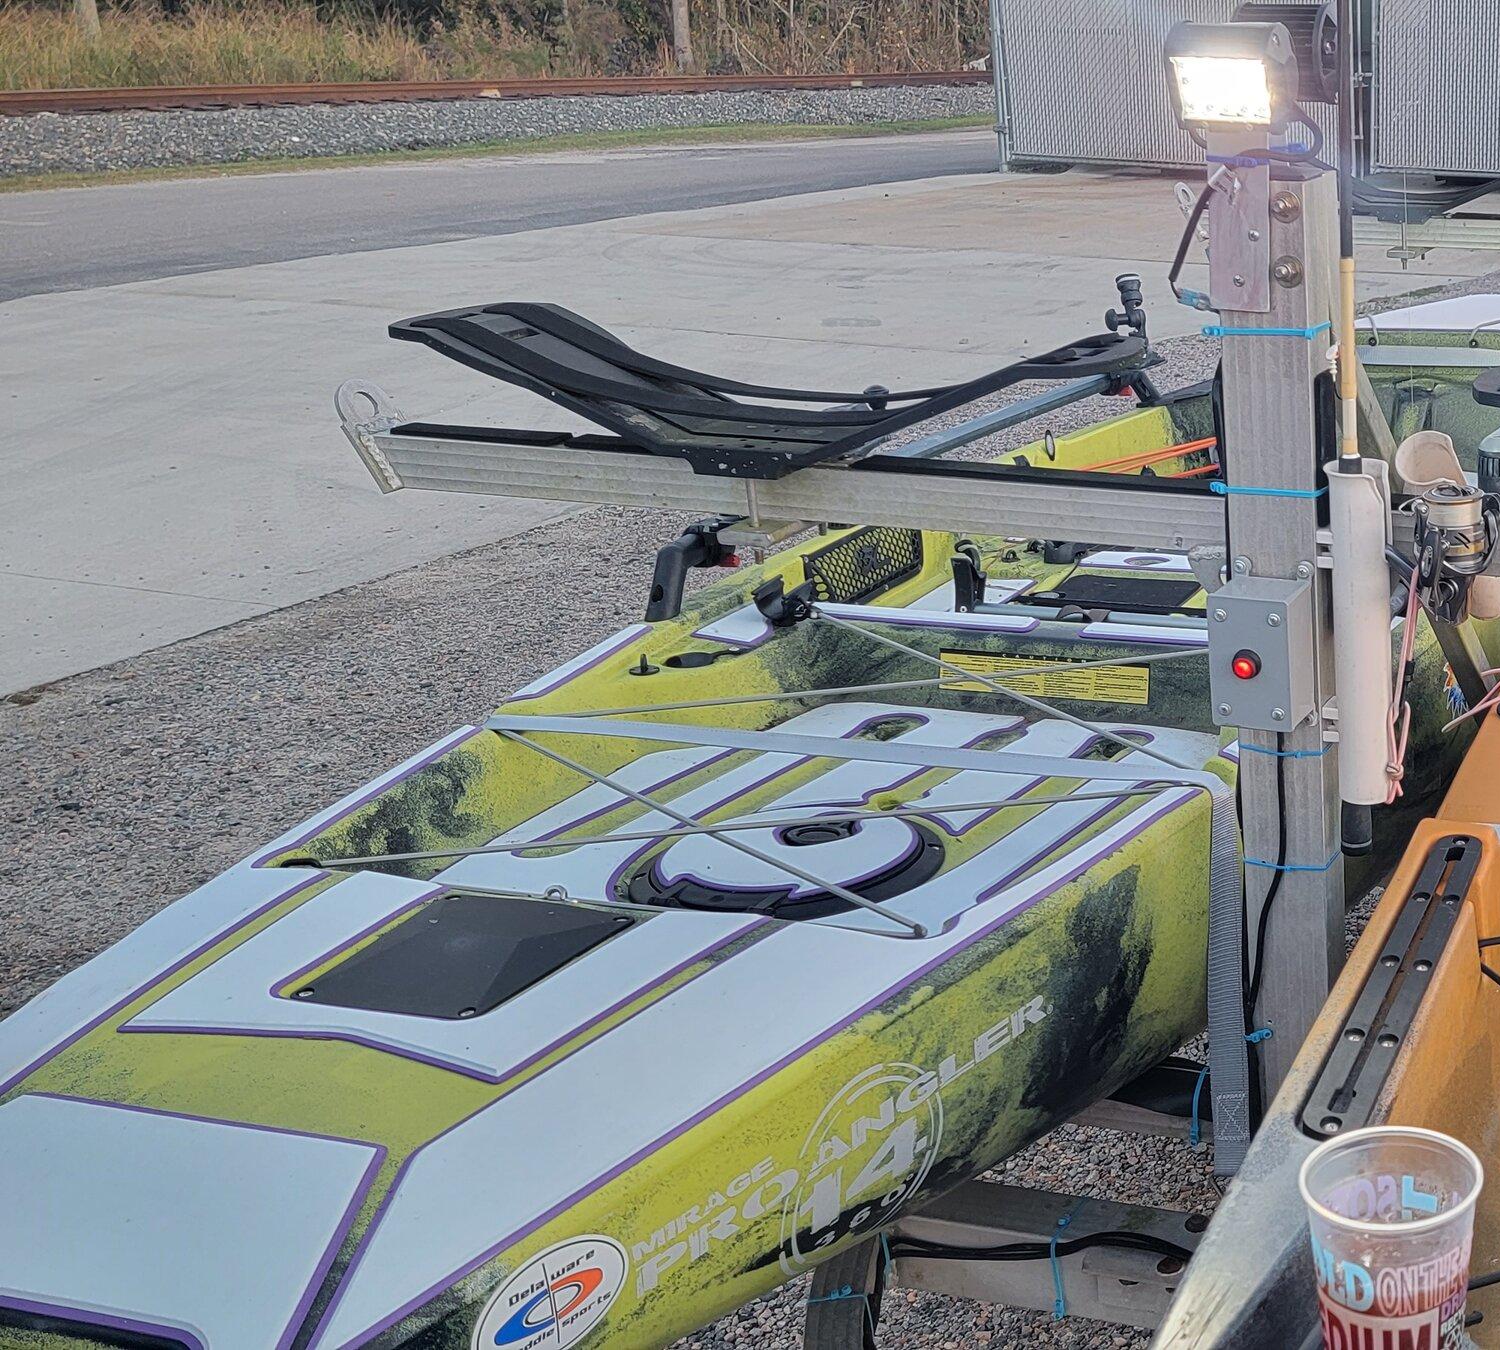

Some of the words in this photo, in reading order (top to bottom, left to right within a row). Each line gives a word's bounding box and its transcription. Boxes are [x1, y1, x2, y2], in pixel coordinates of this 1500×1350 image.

[1002, 652, 1087, 664] CAUTION
[636, 1169, 800, 1299] PRO
[805, 994, 1047, 1182] ANGLER
[799, 1115, 929, 1235] 14
[631, 1155, 775, 1264] MIRAGE
[561, 1290, 612, 1328] sports
